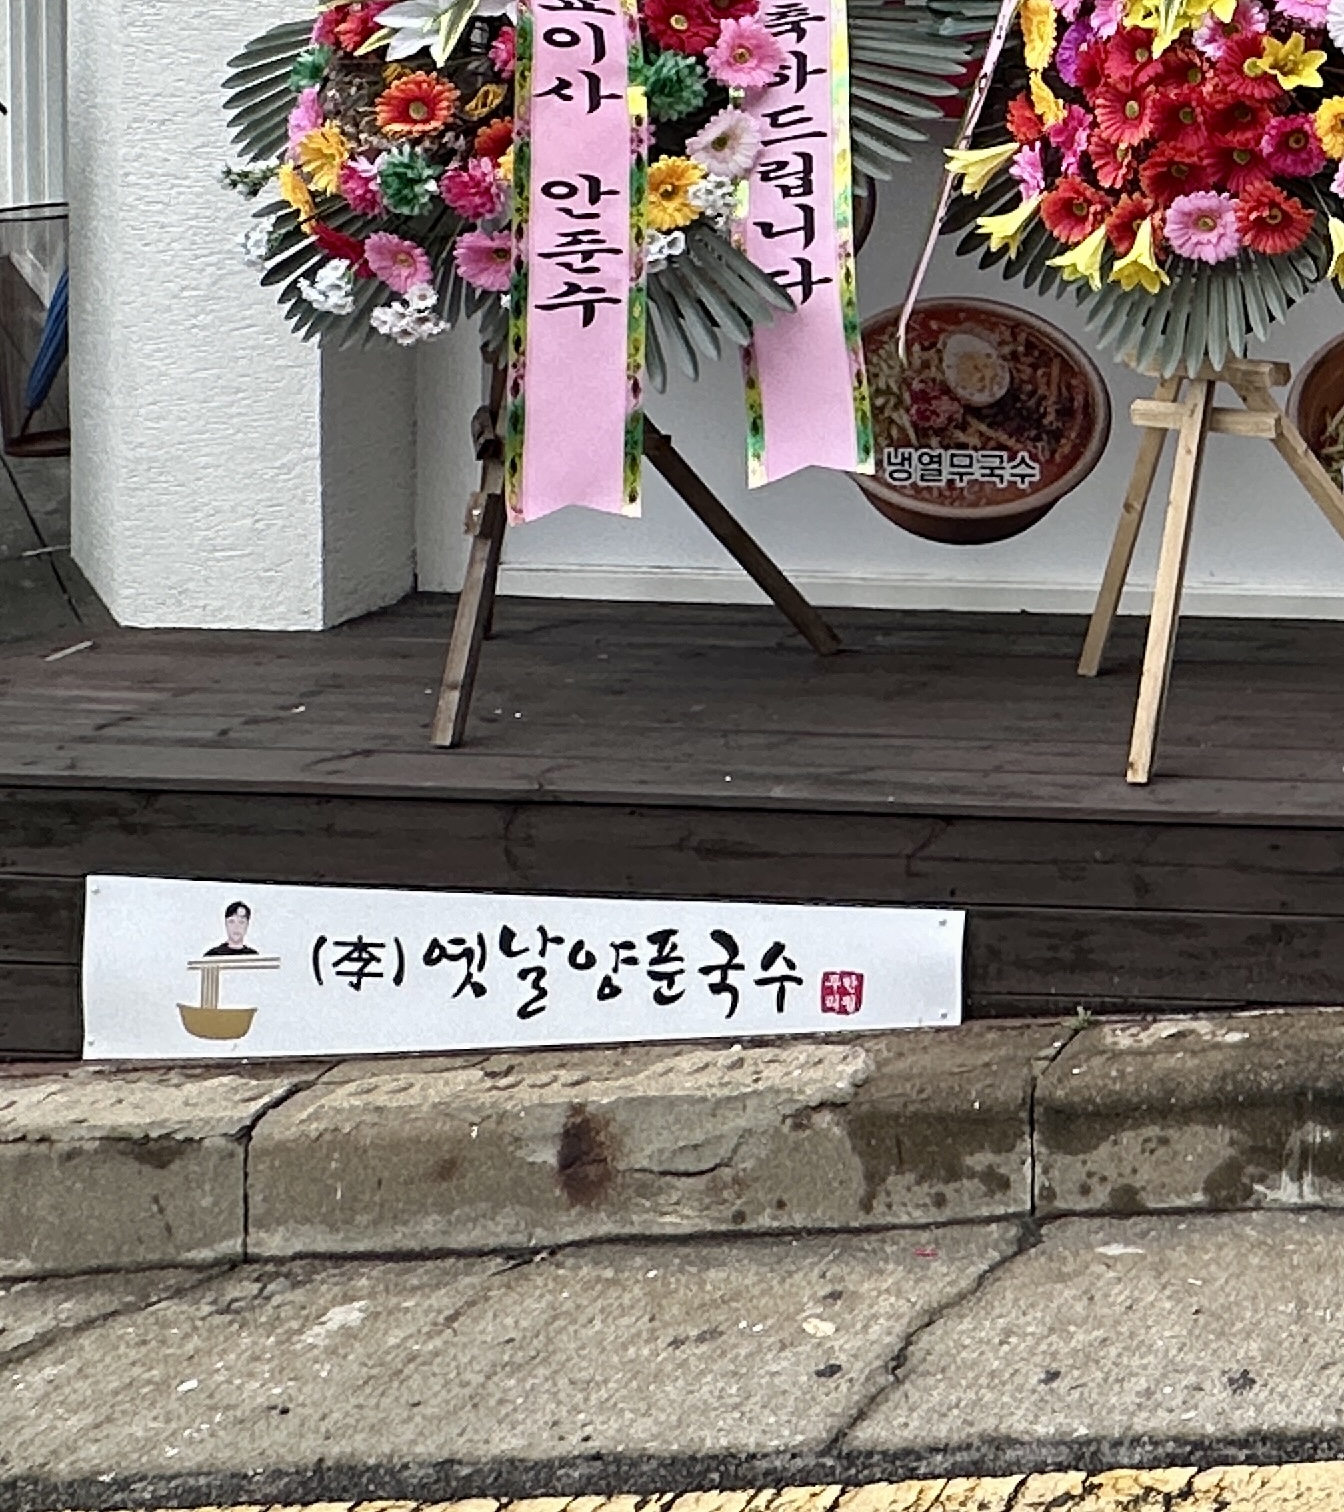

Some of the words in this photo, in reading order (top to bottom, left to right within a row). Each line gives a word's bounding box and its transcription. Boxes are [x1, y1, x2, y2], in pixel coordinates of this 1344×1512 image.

[752, 0, 833, 306] 축하드립니다
[883, 450, 1041, 486] 냉열무국수
[424, 925, 804, 1019] 옛날양푼국수
